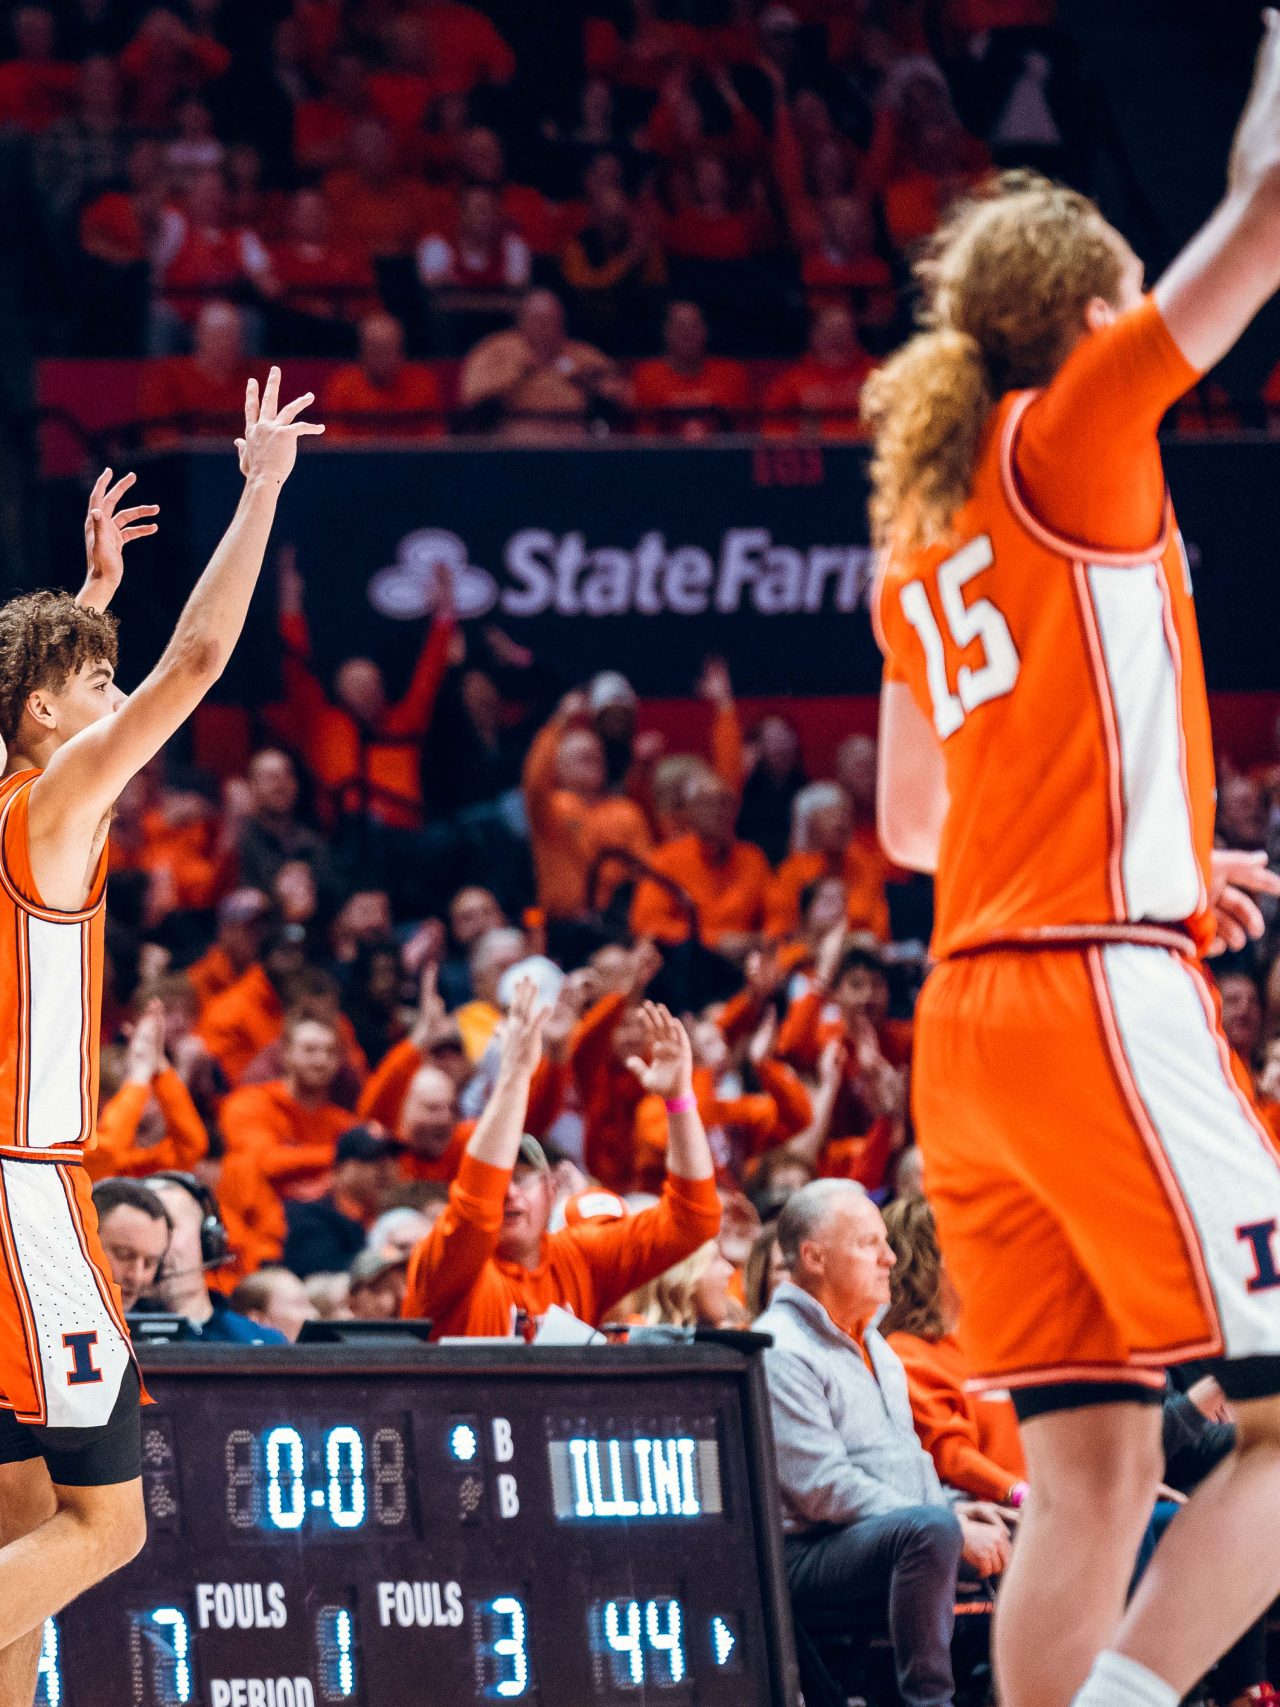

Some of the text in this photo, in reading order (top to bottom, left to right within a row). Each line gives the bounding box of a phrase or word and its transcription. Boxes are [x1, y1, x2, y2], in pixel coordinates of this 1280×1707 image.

[900, 533, 1020, 740] 15
[1234, 1217, 1280, 1295] I
[61, 1329, 103, 1386] I
[492, 1417, 514, 1462] B
[570, 1439, 700, 1516] ILLINI
[497, 1474, 520, 1518] B
[196, 1582, 288, 1629] FOULS
[377, 1581, 464, 1627] FOULS
[604, 1600, 683, 1684] 44
[152, 1608, 189, 1702] 7
[336, 1610, 353, 1696] 1
[492, 1597, 527, 1697] 3
[210, 1677, 315, 1707] PERIOD
